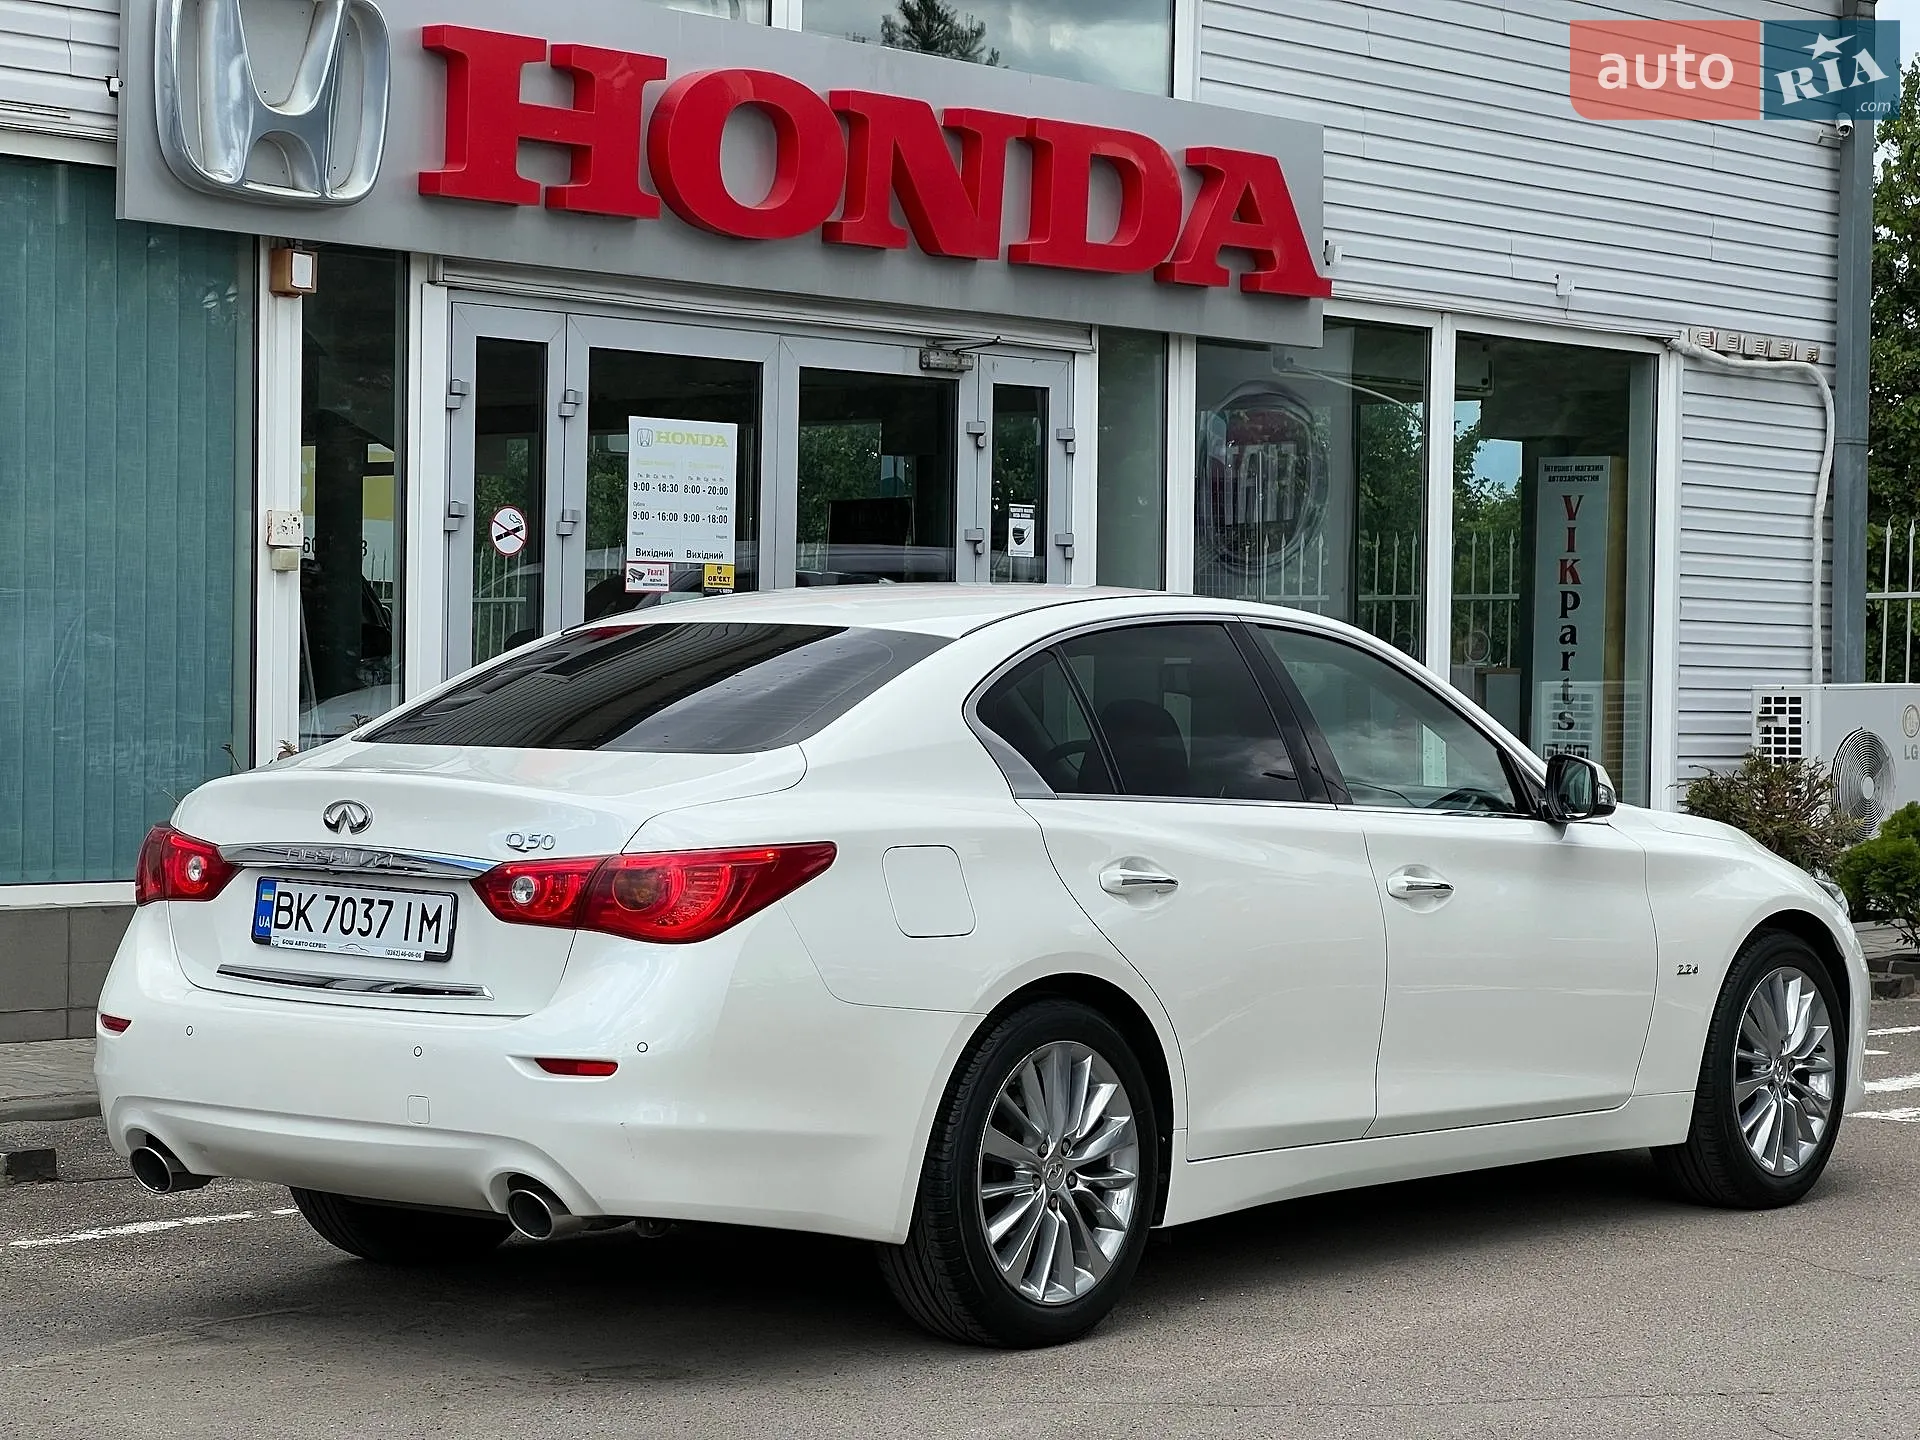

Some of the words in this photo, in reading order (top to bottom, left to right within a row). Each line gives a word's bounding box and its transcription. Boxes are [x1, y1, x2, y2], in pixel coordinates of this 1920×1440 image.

[417, 25, 1333, 299] HONDA
[655, 430, 728, 448] HONDA
[633, 482, 650, 492] 9:00
[658, 483, 679, 493] 18:30
[683, 484, 701, 494] 8:00
[707, 485, 729, 496] 20:00
[632, 510, 650, 521] 9:00
[657, 511, 679, 522] 16:00
[683, 513, 700, 523] 9:00
[707, 514, 728, 524] 18:00
[635, 547, 674, 559] Вихідний
[686, 549, 724, 560] Вихідний
[1904, 744, 1919, 761] LG
[505, 832, 556, 853] Q50
[258, 915, 270, 928] UA
[273, 890, 320, 933] BK
[322, 894, 395, 939] 7037
[403, 901, 443, 945] IM
